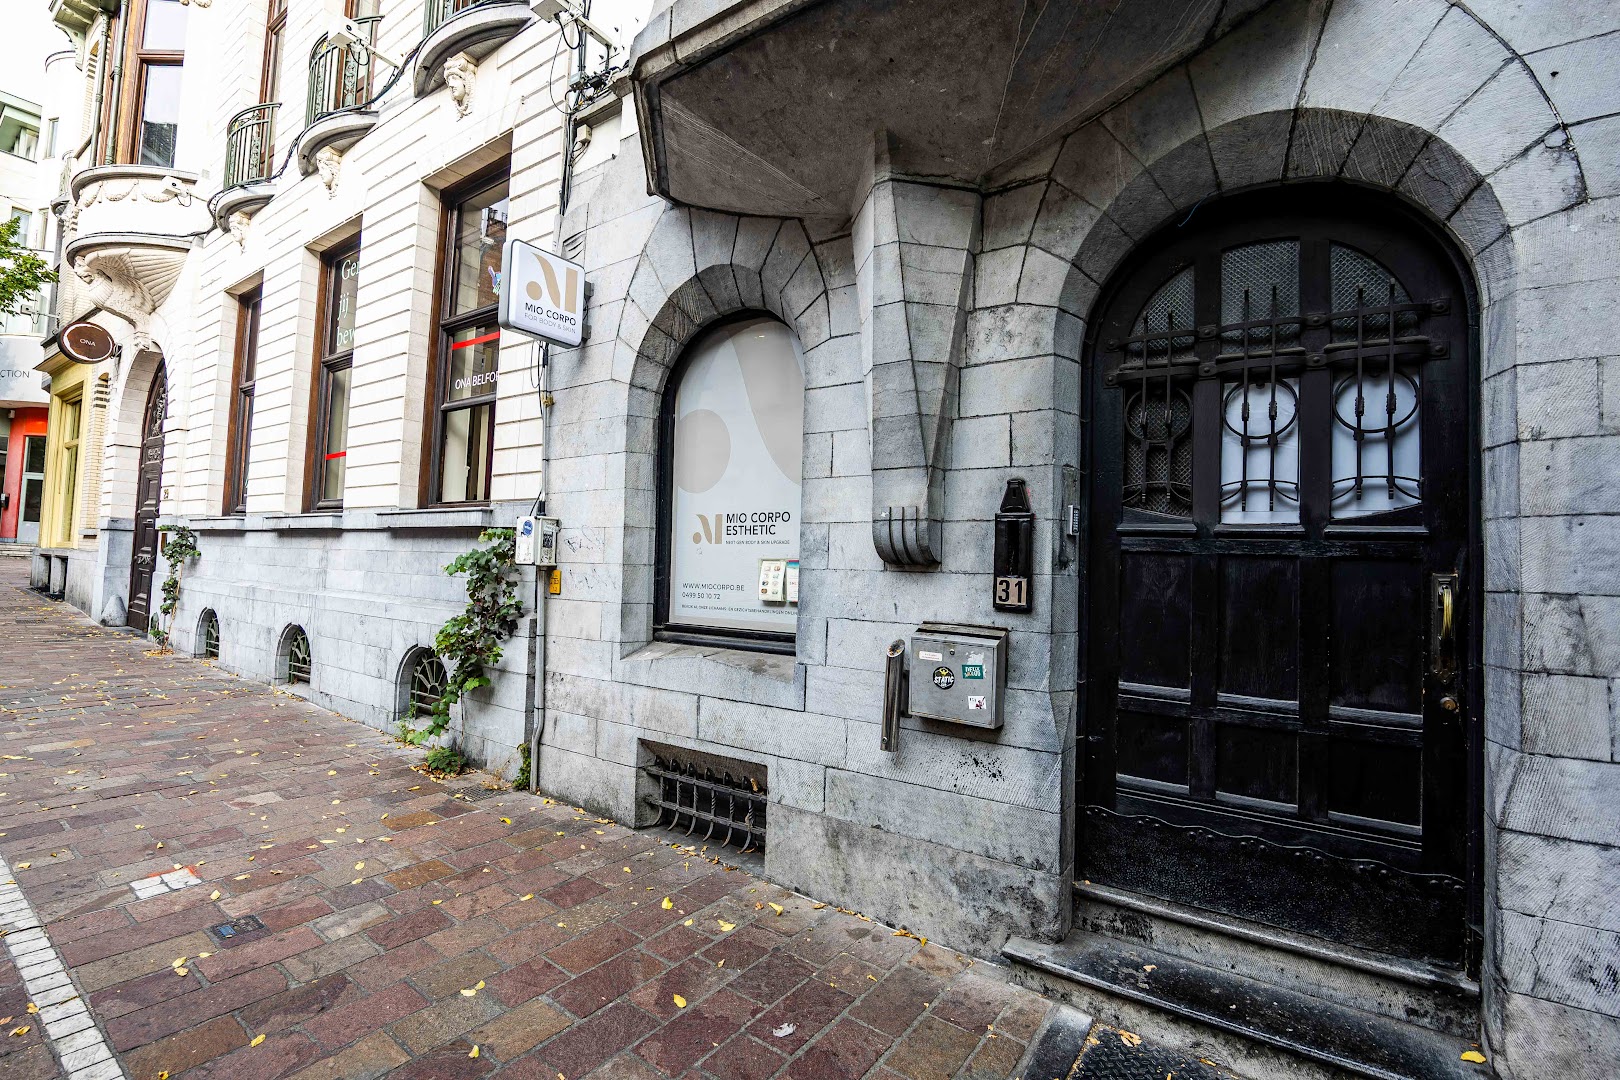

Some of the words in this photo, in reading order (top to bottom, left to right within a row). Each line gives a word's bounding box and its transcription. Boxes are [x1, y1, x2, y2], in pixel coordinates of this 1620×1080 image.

[337, 291, 349, 321] jij
[525, 302, 544, 315] MIO
[546, 309, 577, 326] CORPO
[524, 312, 538, 322] FOR
[539, 317, 557, 328] BODY
[562, 324, 576, 334] SKIN
[79, 338, 96, 346] ONA
[0, 369, 30, 378] CTION
[455, 377, 471, 390] ONA
[726, 512, 747, 524] MIO
[750, 511, 791, 523] CORPO
[726, 524, 776, 536] ESTHETIC
[682, 583, 745, 592] WWW.MIOCORPO.BE
[998, 579, 1023, 604] 31
[934, 675, 954, 684] STATIC
